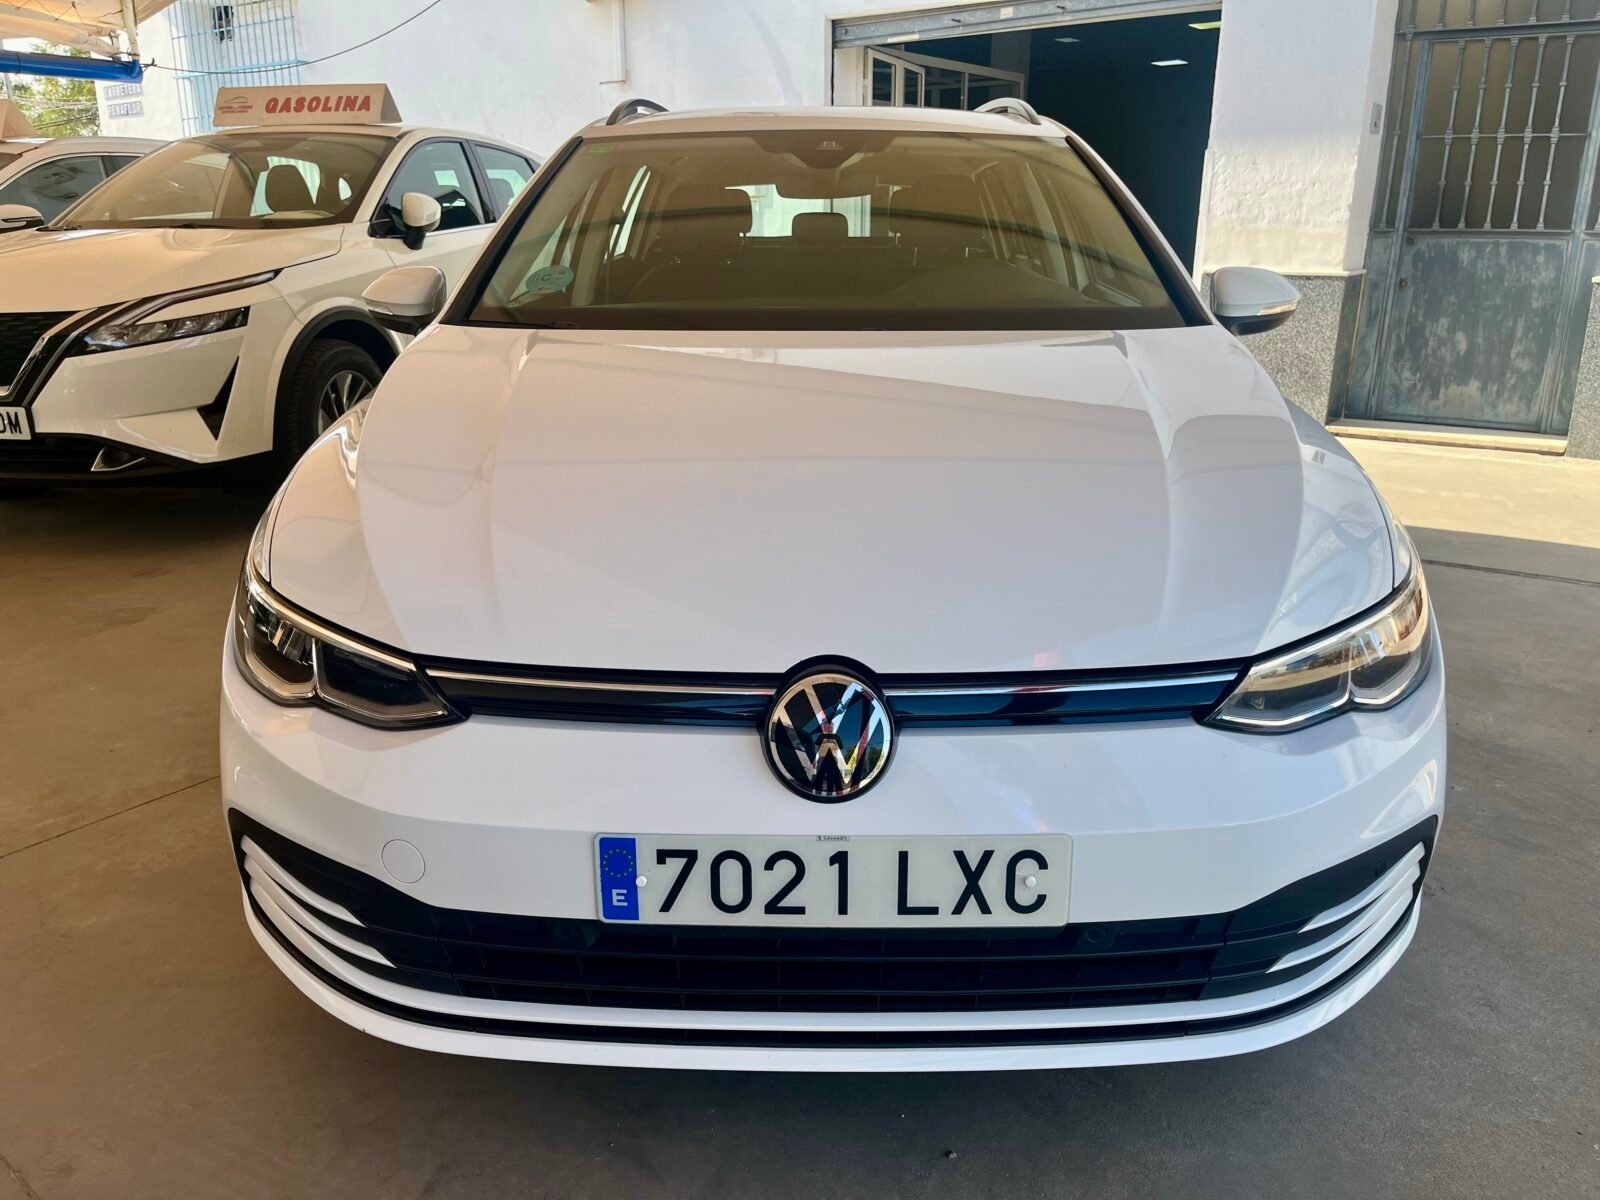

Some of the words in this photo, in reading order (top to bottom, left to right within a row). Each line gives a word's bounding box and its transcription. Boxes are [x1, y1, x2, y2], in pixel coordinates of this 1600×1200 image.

[265, 95, 371, 114] GASOLINA
[655, 848, 848, 915] 7021
[897, 849, 1049, 915] LXC
[611, 889, 629, 907] E
